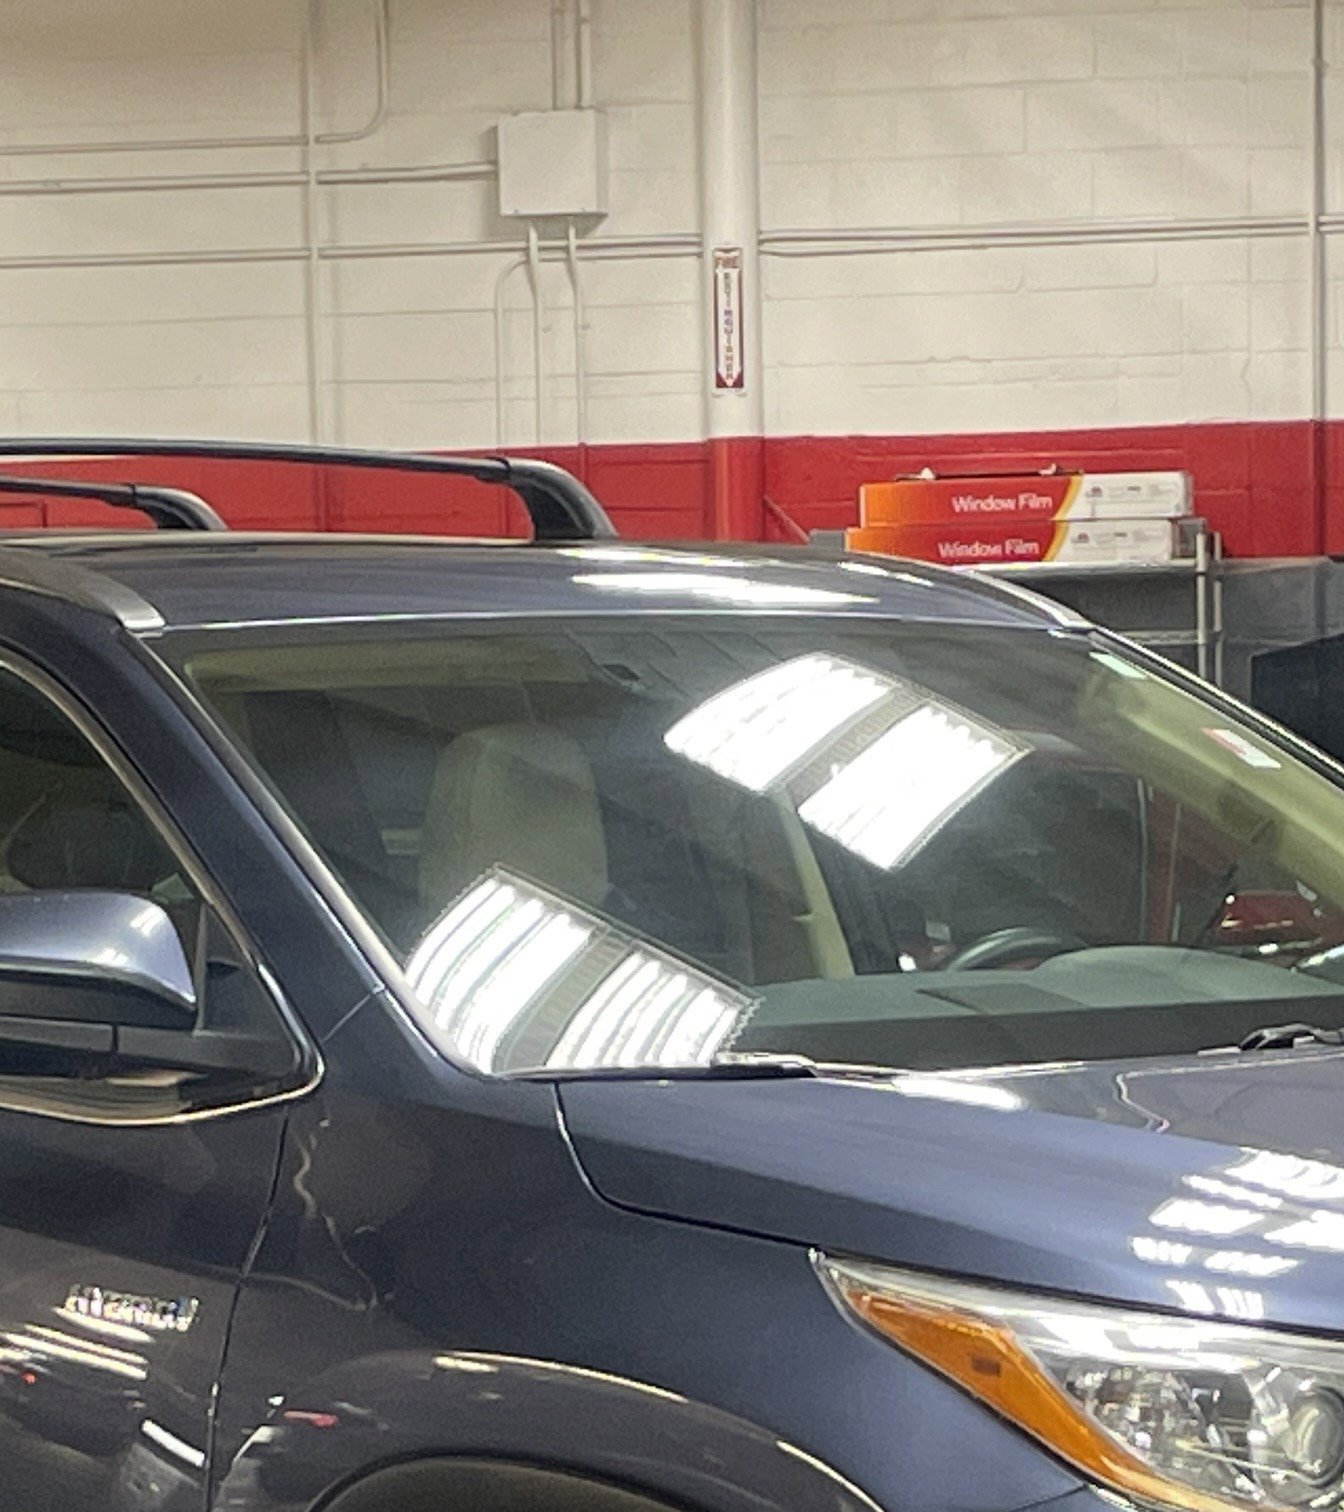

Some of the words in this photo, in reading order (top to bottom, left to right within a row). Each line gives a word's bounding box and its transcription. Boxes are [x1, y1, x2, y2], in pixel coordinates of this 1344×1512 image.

[951, 494, 1016, 513] Window
[1018, 492, 1053, 511] Film
[937, 541, 1002, 558] Window
[1004, 538, 1040, 556] Film
